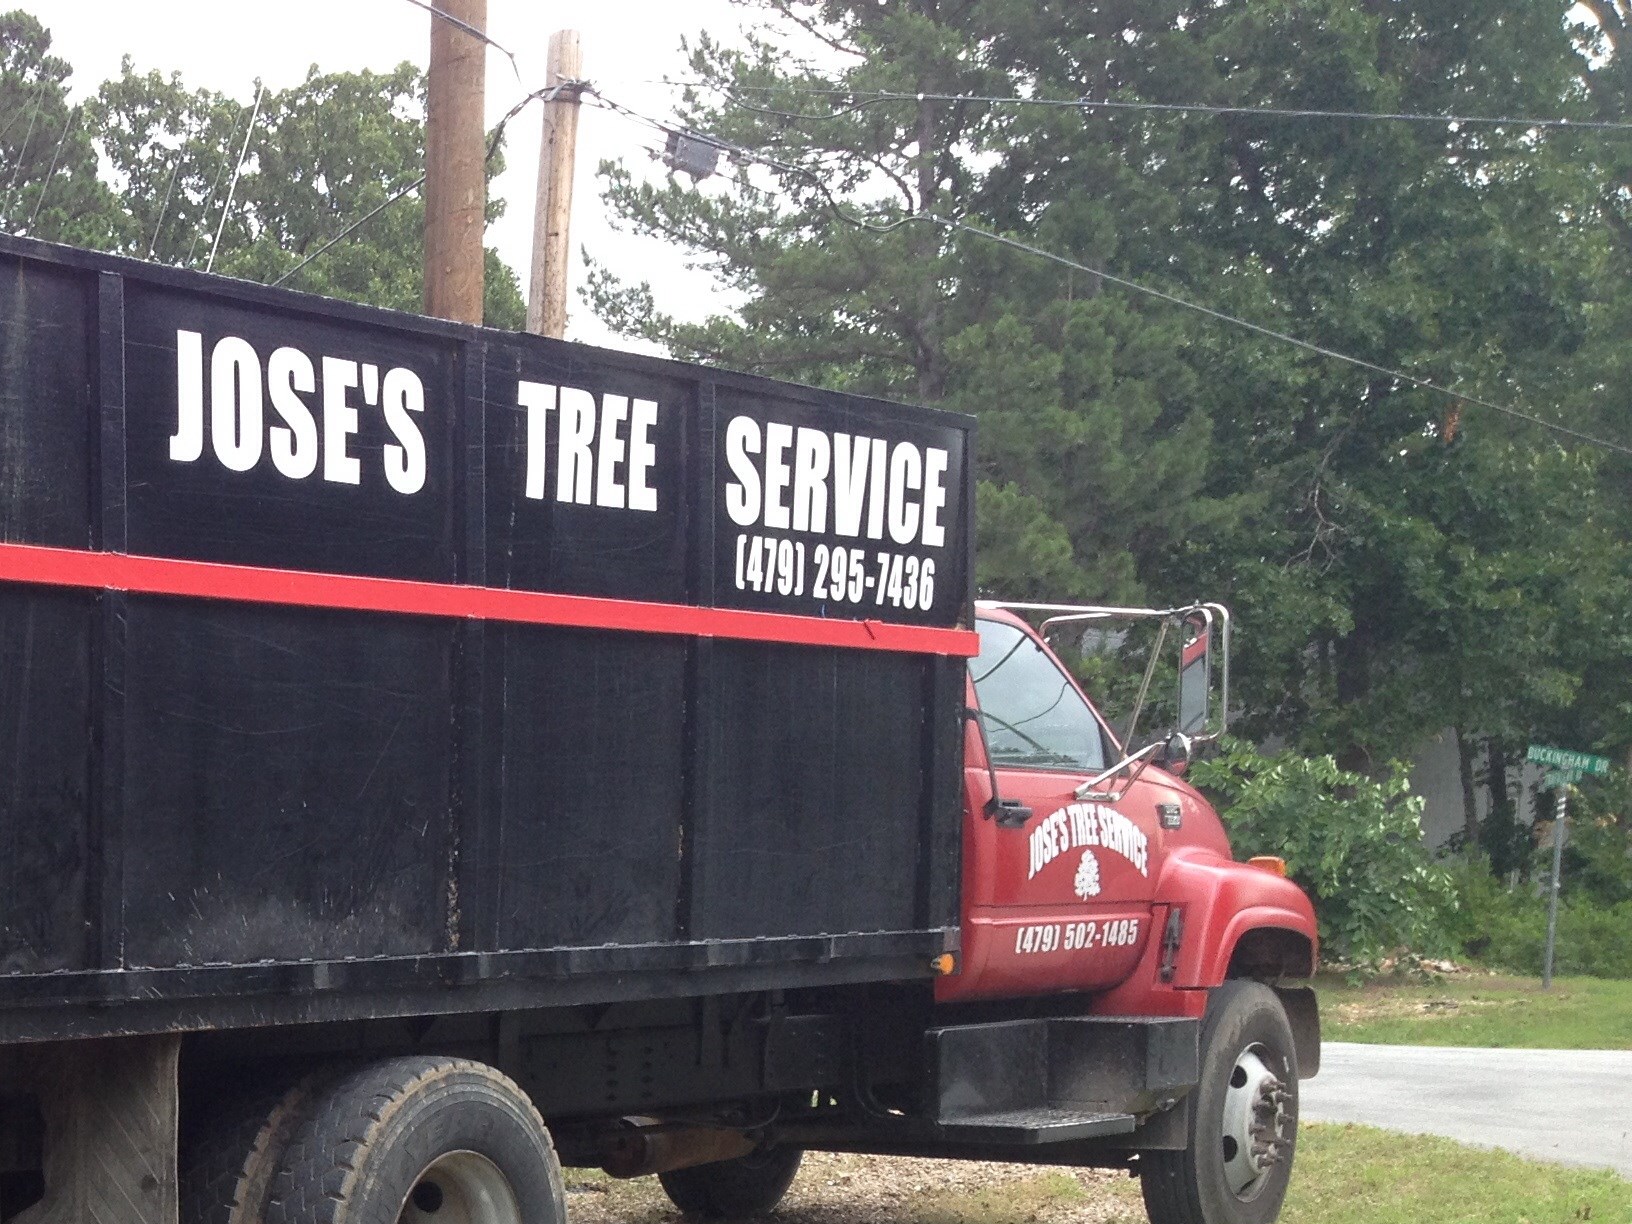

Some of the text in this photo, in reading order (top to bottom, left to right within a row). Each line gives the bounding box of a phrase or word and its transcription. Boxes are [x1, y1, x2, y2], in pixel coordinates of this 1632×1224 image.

[169, 329, 949, 548] JOSE'S TREE SERVICE
[736, 533, 936, 611] (479) 295-7436
[1528, 746, 1609, 774] BUCKINGHAM DR
[1067, 803, 1099, 848] TREE
[1097, 804, 1148, 879] SERVICE
[1015, 919, 1139, 954] (479) 502-1485
